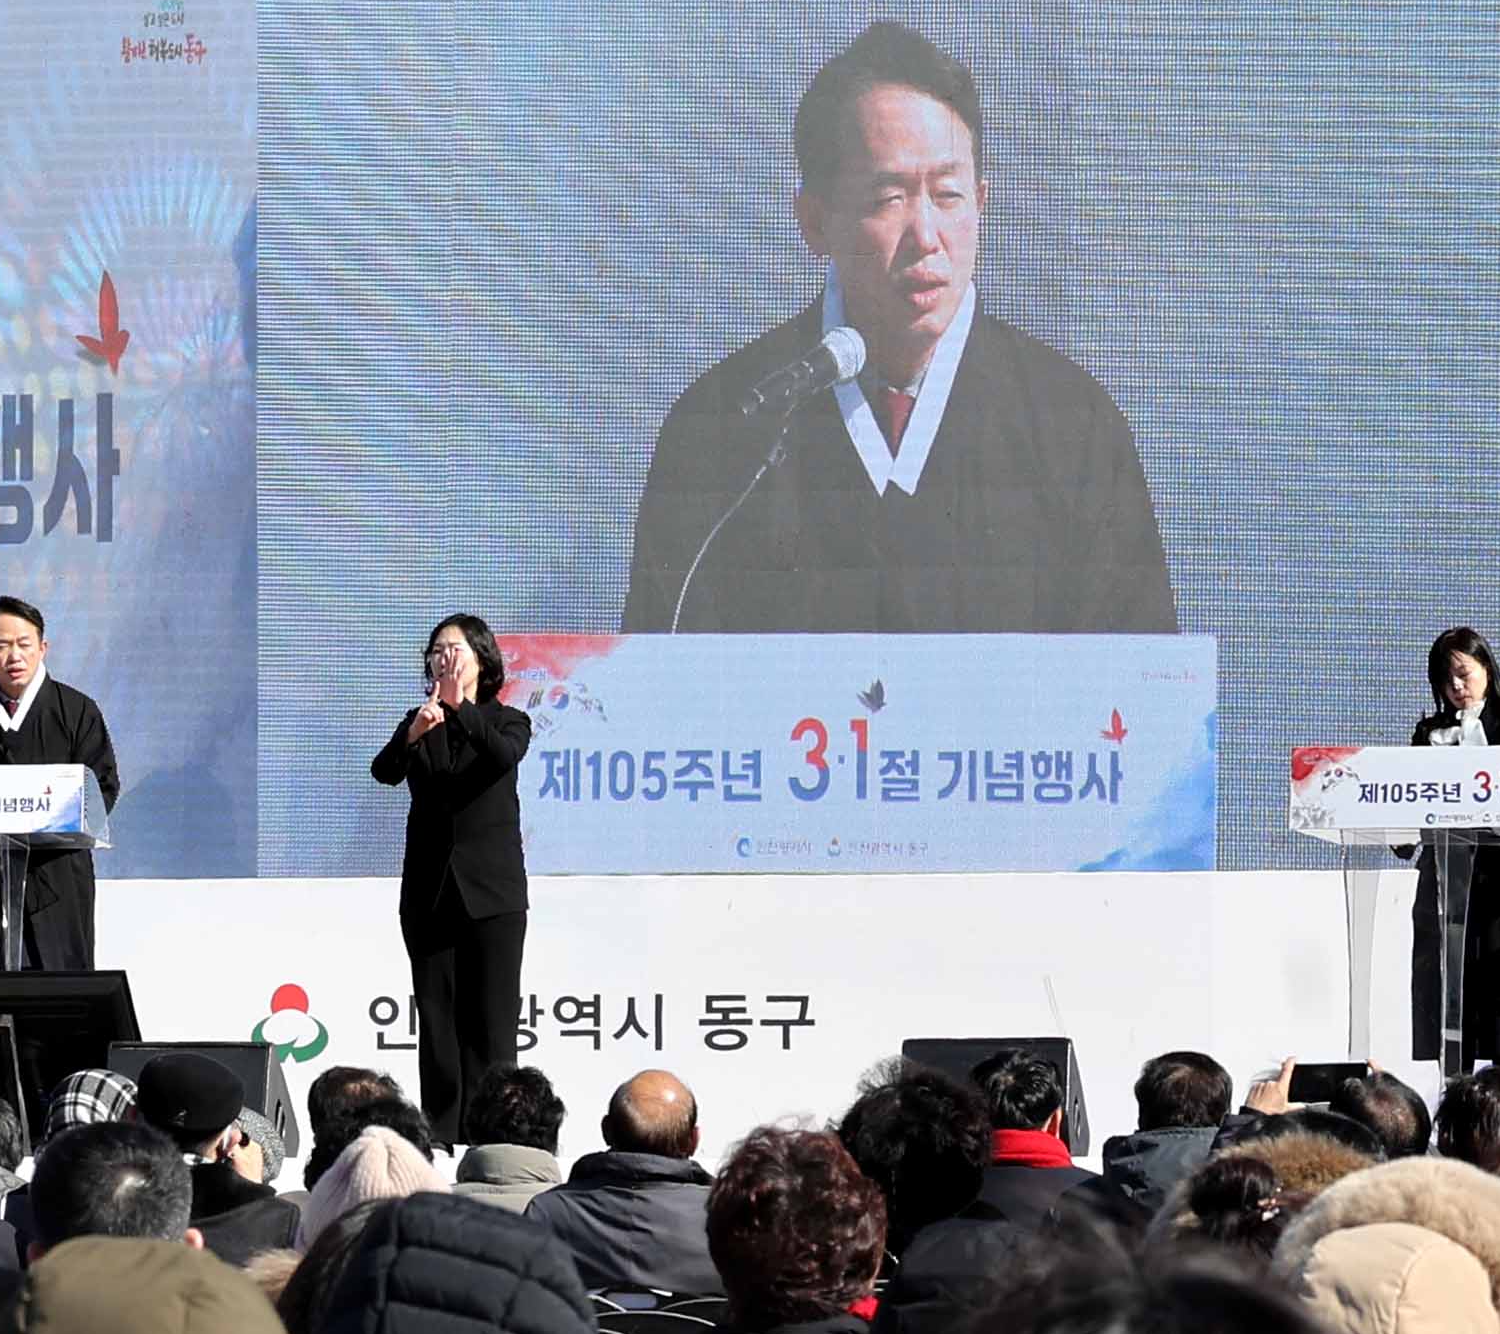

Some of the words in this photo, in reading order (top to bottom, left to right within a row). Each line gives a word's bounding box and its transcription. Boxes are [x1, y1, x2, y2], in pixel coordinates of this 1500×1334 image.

[537, 748, 763, 803] 제105주년
[936, 747, 1124, 805] 기념행사
[1358, 781, 1461, 804] 제105주년
[368, 993, 664, 1052] 인역시
[698, 993, 816, 1052] 동구
